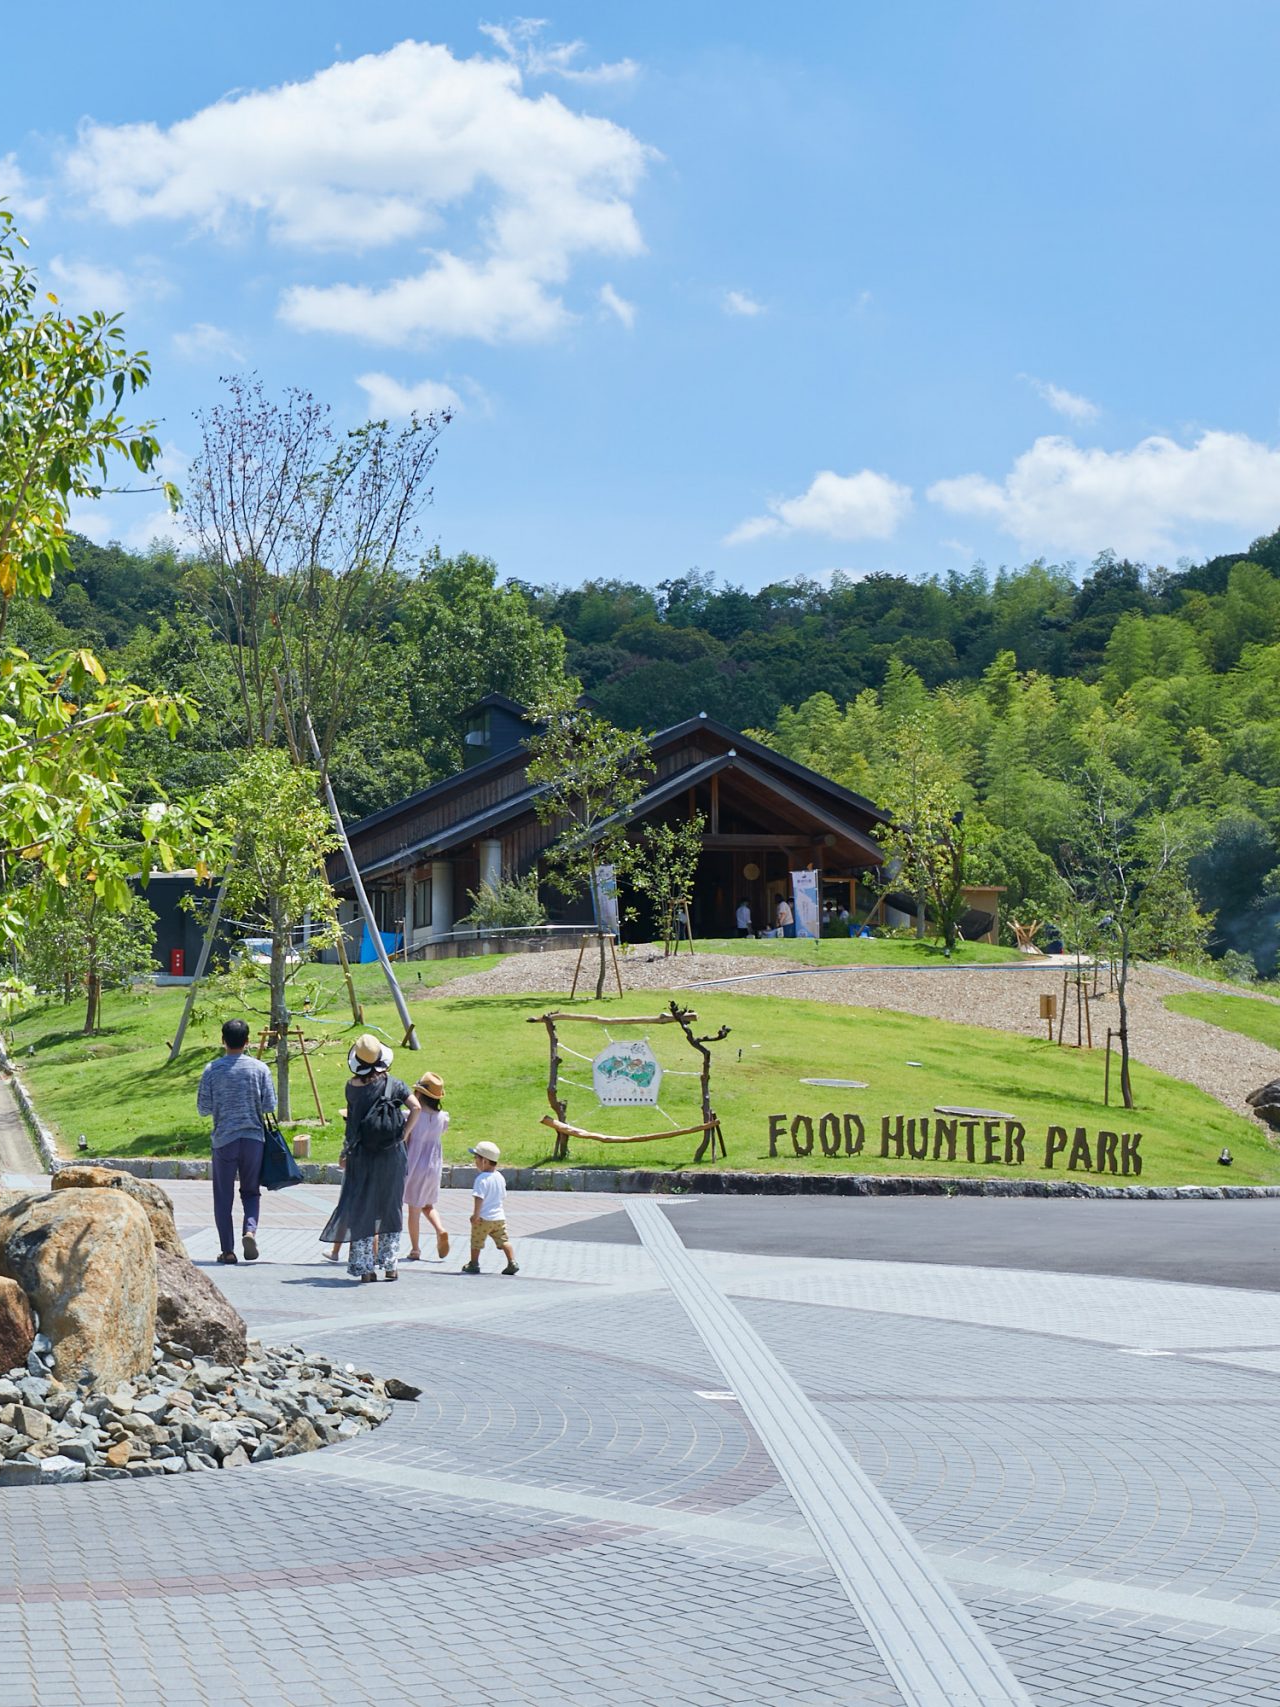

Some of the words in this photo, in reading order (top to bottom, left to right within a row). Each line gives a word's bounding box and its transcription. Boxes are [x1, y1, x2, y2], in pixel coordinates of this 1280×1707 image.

[768, 1112, 865, 1157] FOOD
[881, 1115, 1026, 1164] HUNTER
[1044, 1125, 1143, 1175] PARK
